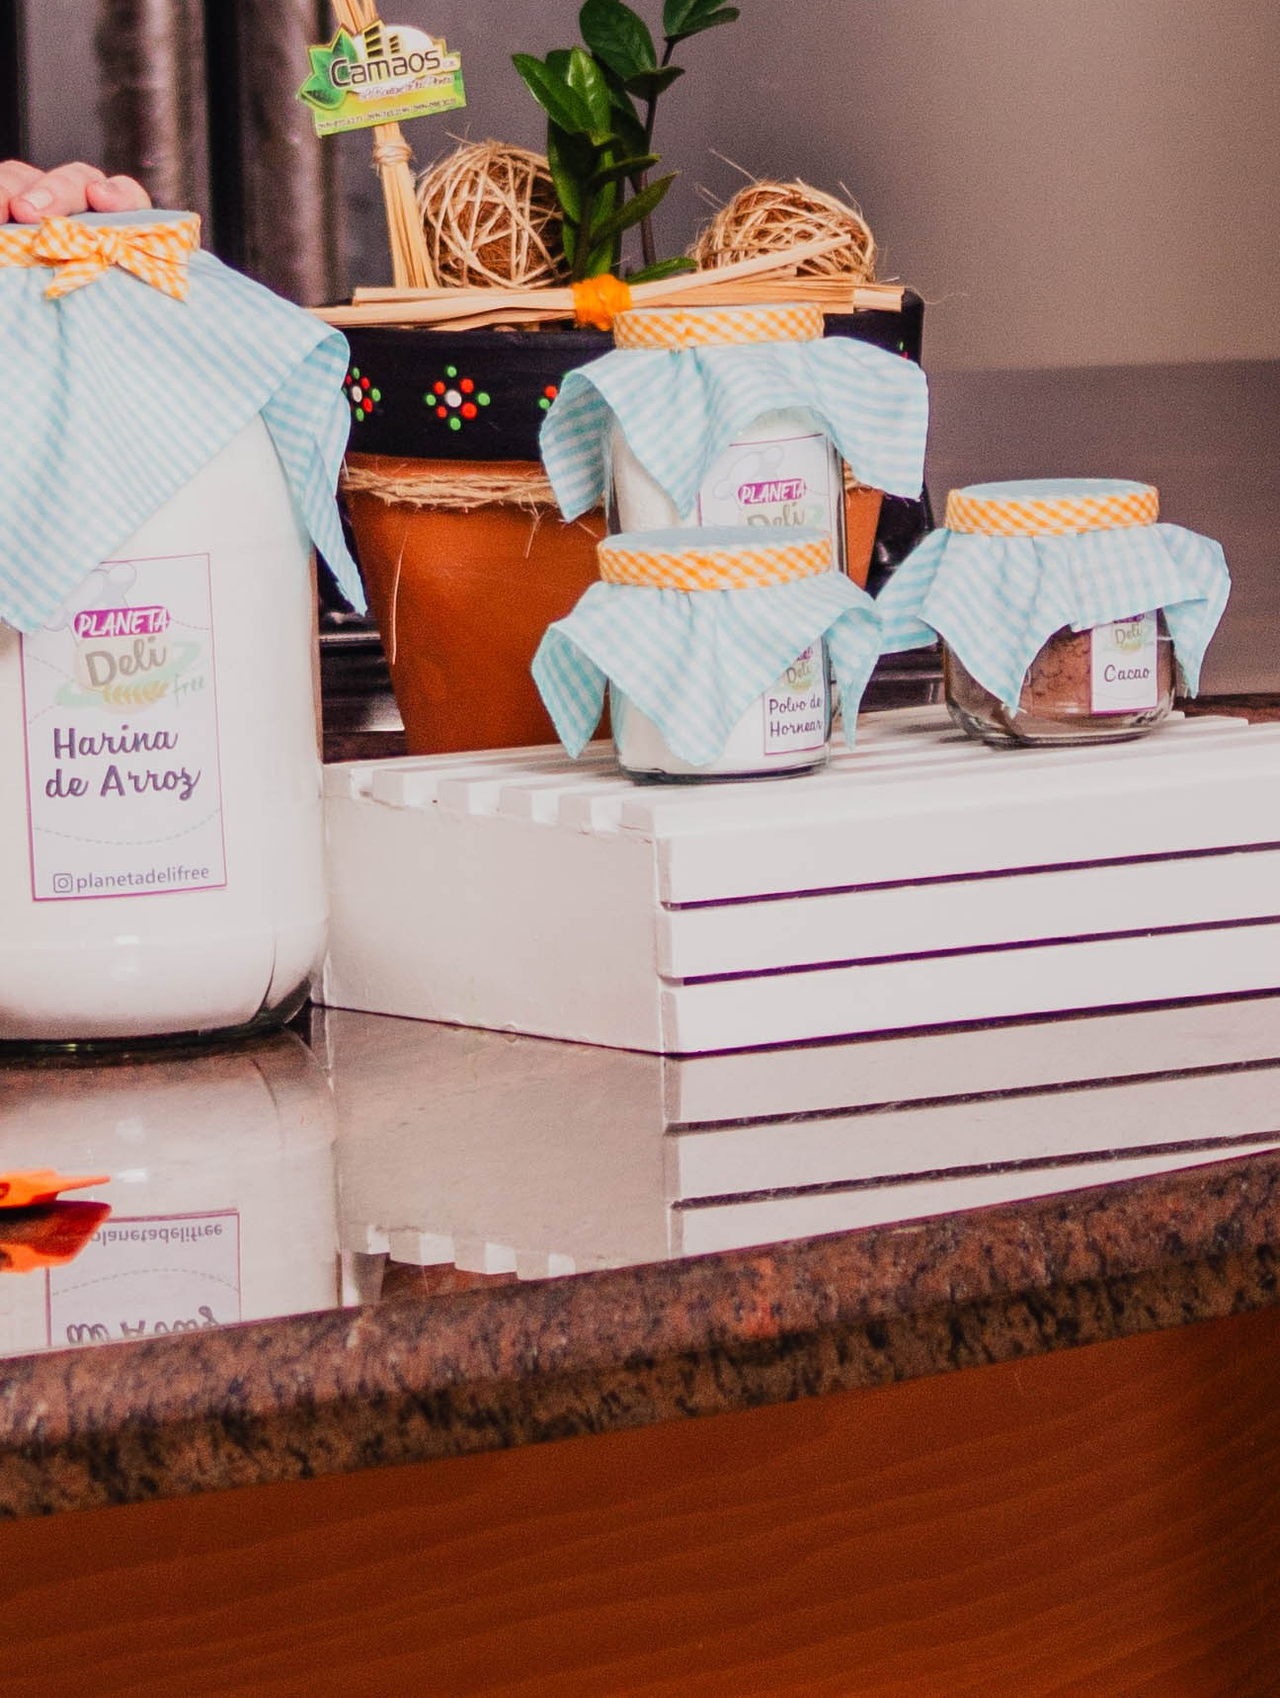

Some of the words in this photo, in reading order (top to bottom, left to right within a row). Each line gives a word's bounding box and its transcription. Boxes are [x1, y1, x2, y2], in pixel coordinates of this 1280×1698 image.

[331, 50, 441, 88] Camaos
[741, 481, 805, 504] PLANETA
[77, 610, 170, 638] PLANETA
[1114, 623, 1143, 645] Deli
[85, 636, 167, 688] Deli
[1104, 664, 1150, 683] Cacao
[172, 673, 206, 709] free
[769, 696, 807, 716] Polvo
[810, 694, 823, 709] de
[53, 724, 179, 760] Harina
[770, 719, 823, 738] Hornear
[45, 768, 89, 798] de
[100, 764, 202, 802] Arroz
[77, 865, 210, 894] planetadelifree
